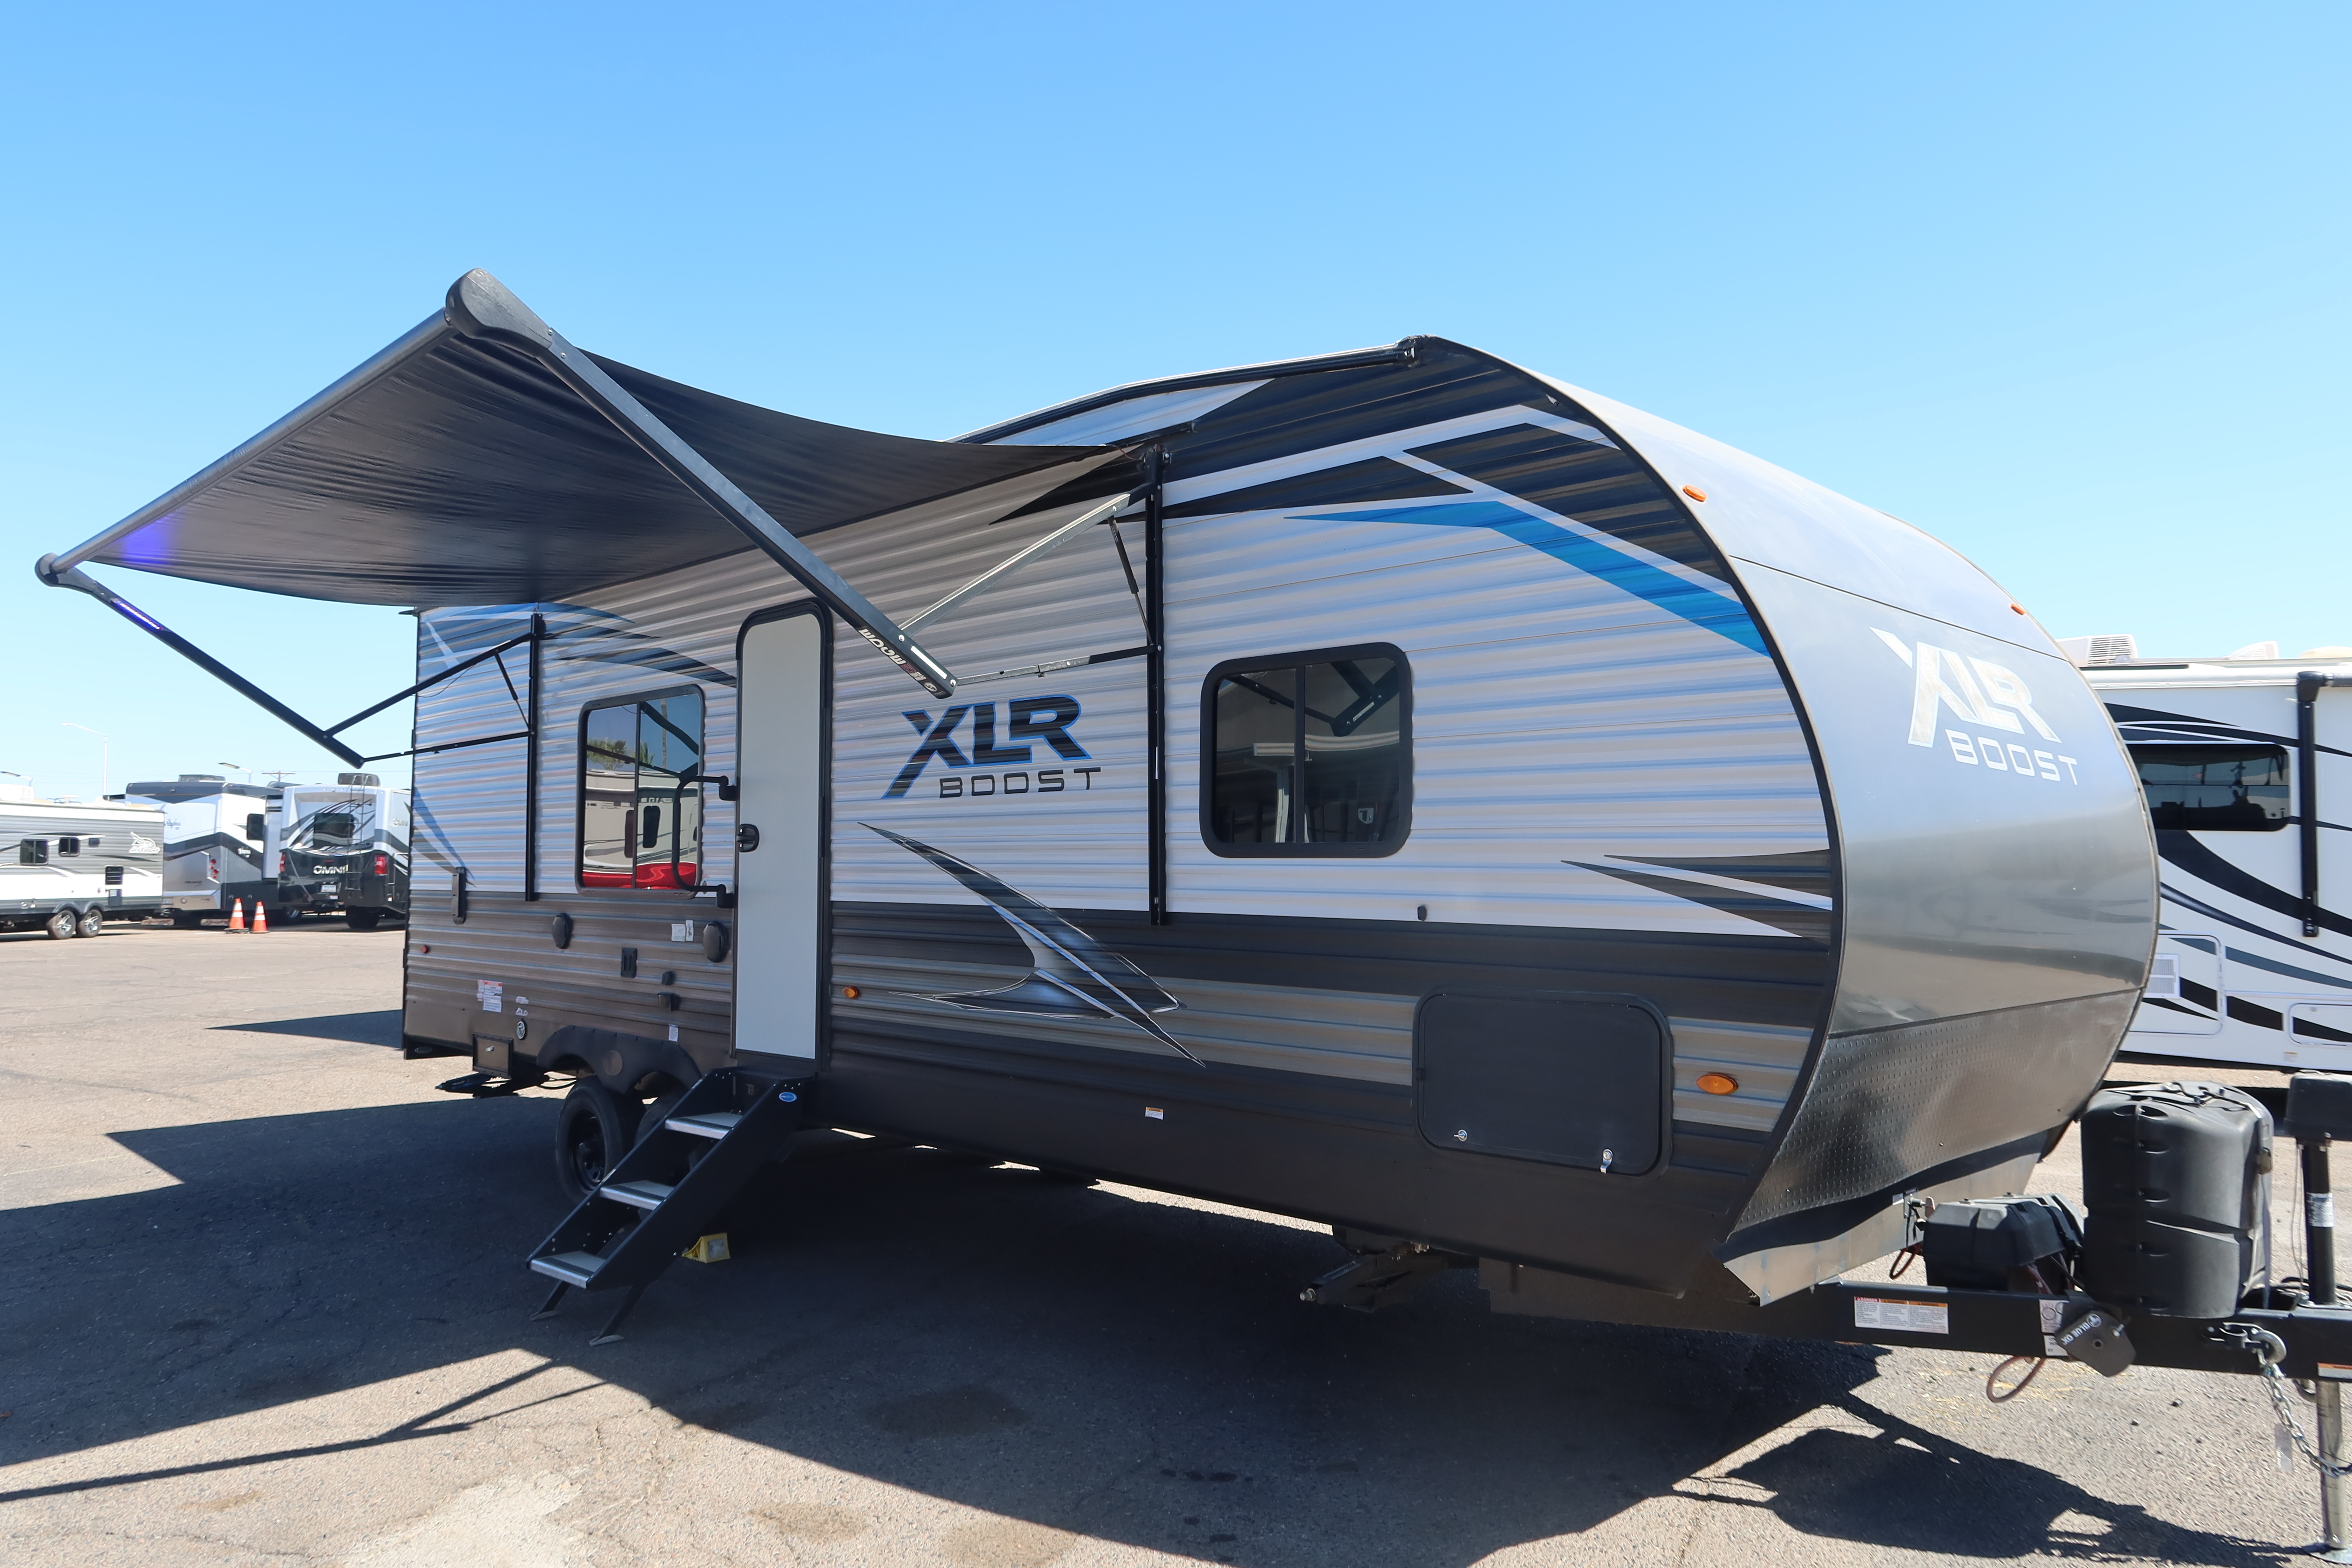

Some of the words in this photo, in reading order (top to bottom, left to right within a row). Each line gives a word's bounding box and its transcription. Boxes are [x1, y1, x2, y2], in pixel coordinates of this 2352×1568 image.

[858, 628, 907, 665] EDGE
[1868, 626, 2062, 748] XLR
[881, 694, 1093, 799] XLR
[1945, 729, 2078, 786] BOOST
[939, 767, 1101, 799] BOOST
